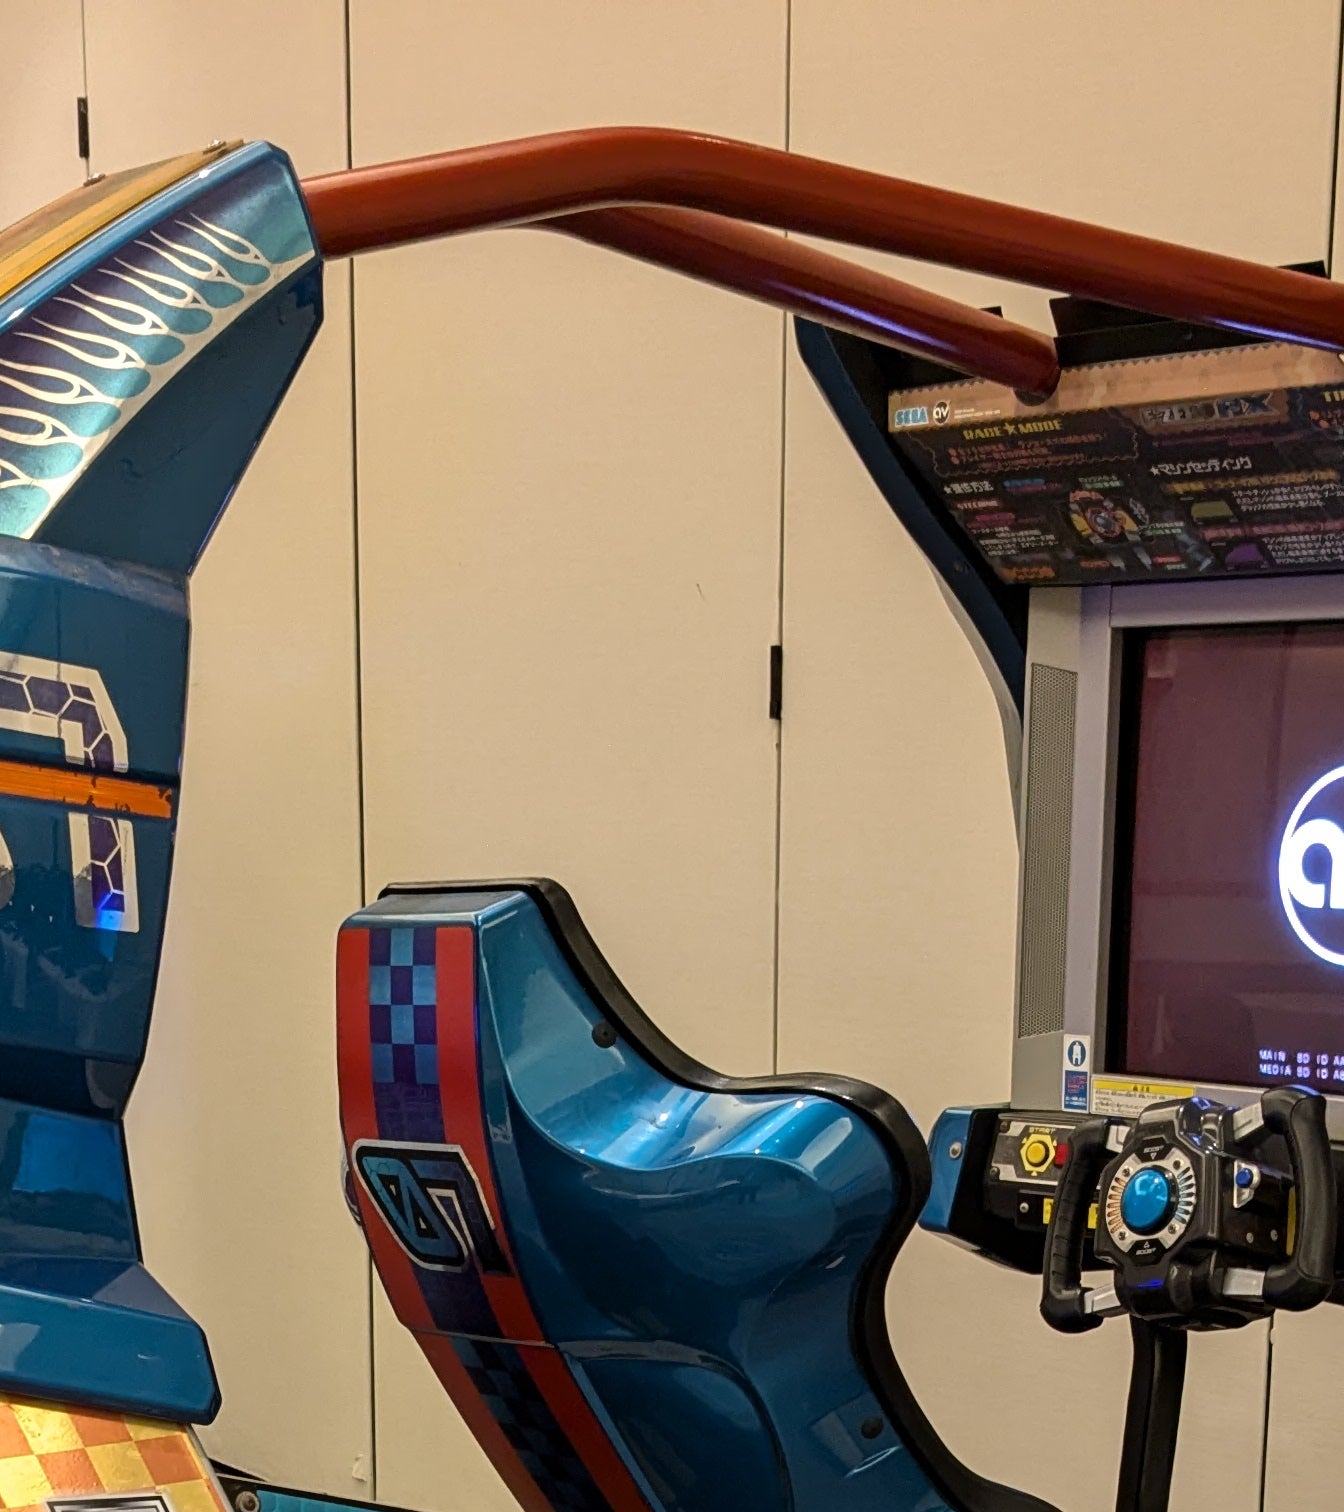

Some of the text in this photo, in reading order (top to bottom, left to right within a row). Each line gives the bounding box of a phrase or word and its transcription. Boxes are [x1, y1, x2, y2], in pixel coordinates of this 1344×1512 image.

[894, 406, 928, 428] SEGA
[963, 419, 1063, 440] RACE MODE
[1259, 1050, 1286, 1062] MAIN
[1317, 1054, 1329, 1065] ID
[1259, 1064, 1292, 1075] MEDIA
[1317, 1068, 1329, 1079] ID
